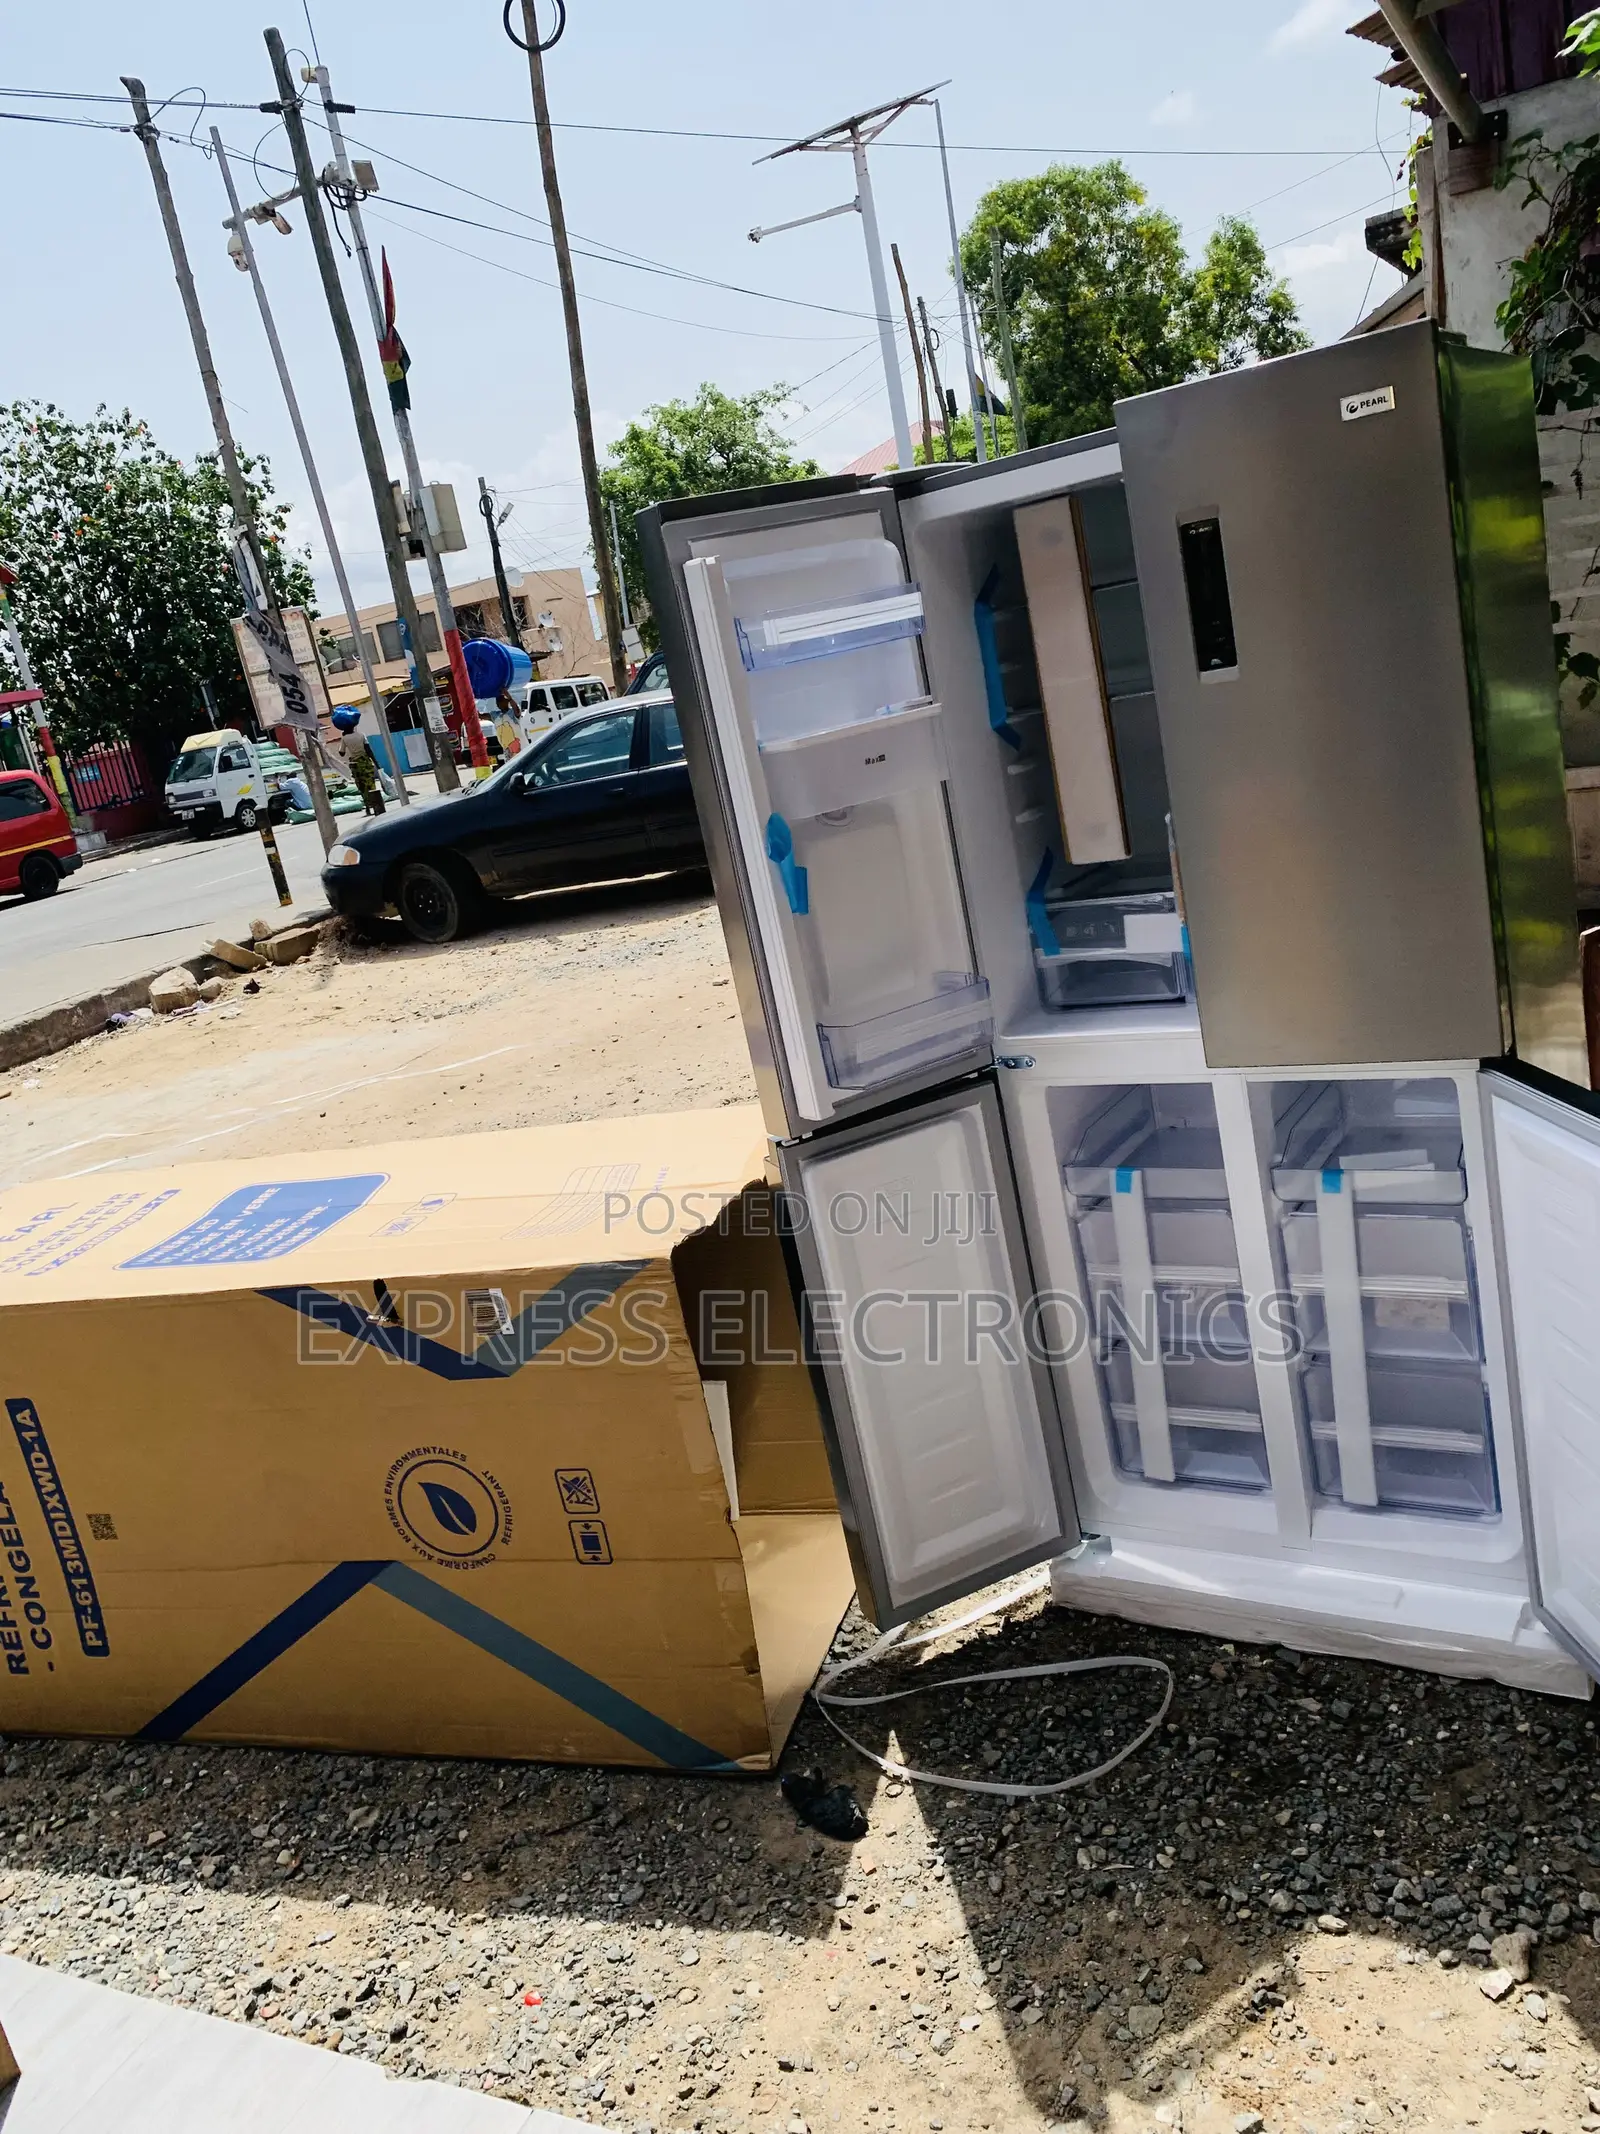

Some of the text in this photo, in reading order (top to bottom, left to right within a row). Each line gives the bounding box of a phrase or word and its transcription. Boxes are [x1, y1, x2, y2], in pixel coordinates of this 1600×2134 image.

[1360, 395, 1388, 409] PEARL
[278, 672, 310, 715] 054
[189, 1218, 220, 1234] LED
[218, 1219, 245, 1230] EN
[236, 1187, 283, 1218] VERRE
[15, 1408, 103, 1647] PF-613MDIXWD-1A
[383, 1446, 497, 1570] CONFORME AUX NORMES ENVIRONMENTALES
[480, 1469, 515, 1546] REFRIGERANT
